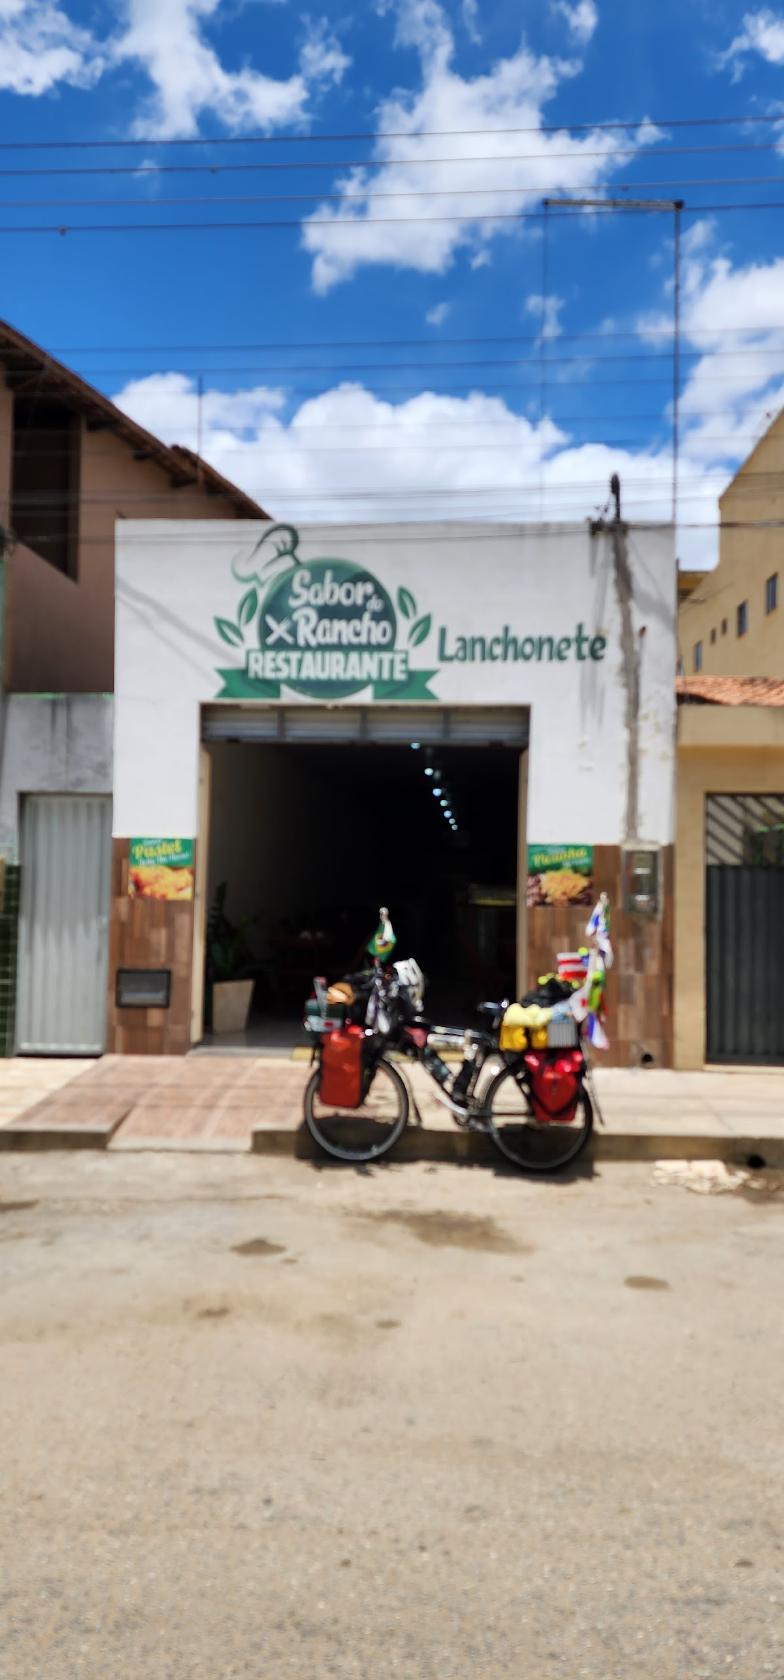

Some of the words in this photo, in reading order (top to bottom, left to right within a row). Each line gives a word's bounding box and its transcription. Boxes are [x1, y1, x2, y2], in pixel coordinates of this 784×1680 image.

[288, 570, 373, 608] Sabor
[367, 596, 384, 613] do
[292, 608, 392, 646] Rancho
[438, 623, 606, 662] Lanchonete
[248, 652, 408, 681] RESTAURANTE
[134, 839, 181, 860] Pastel
